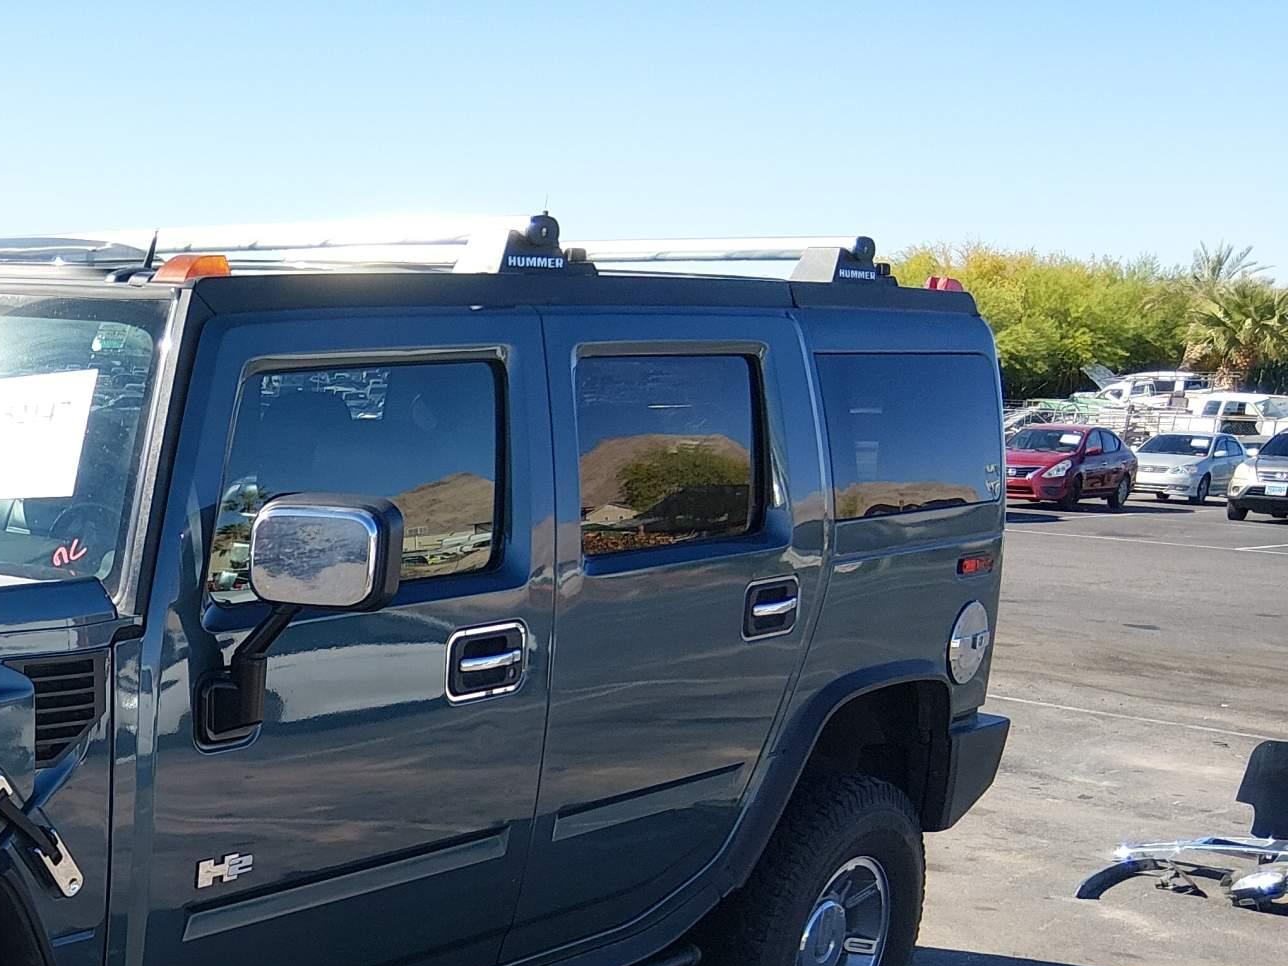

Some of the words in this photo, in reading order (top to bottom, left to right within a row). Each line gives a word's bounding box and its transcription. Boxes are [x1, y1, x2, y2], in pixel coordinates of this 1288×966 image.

[508, 255, 564, 269] HUMMER
[839, 268, 876, 280] HUMMER
[197, 853, 253, 889] H2
